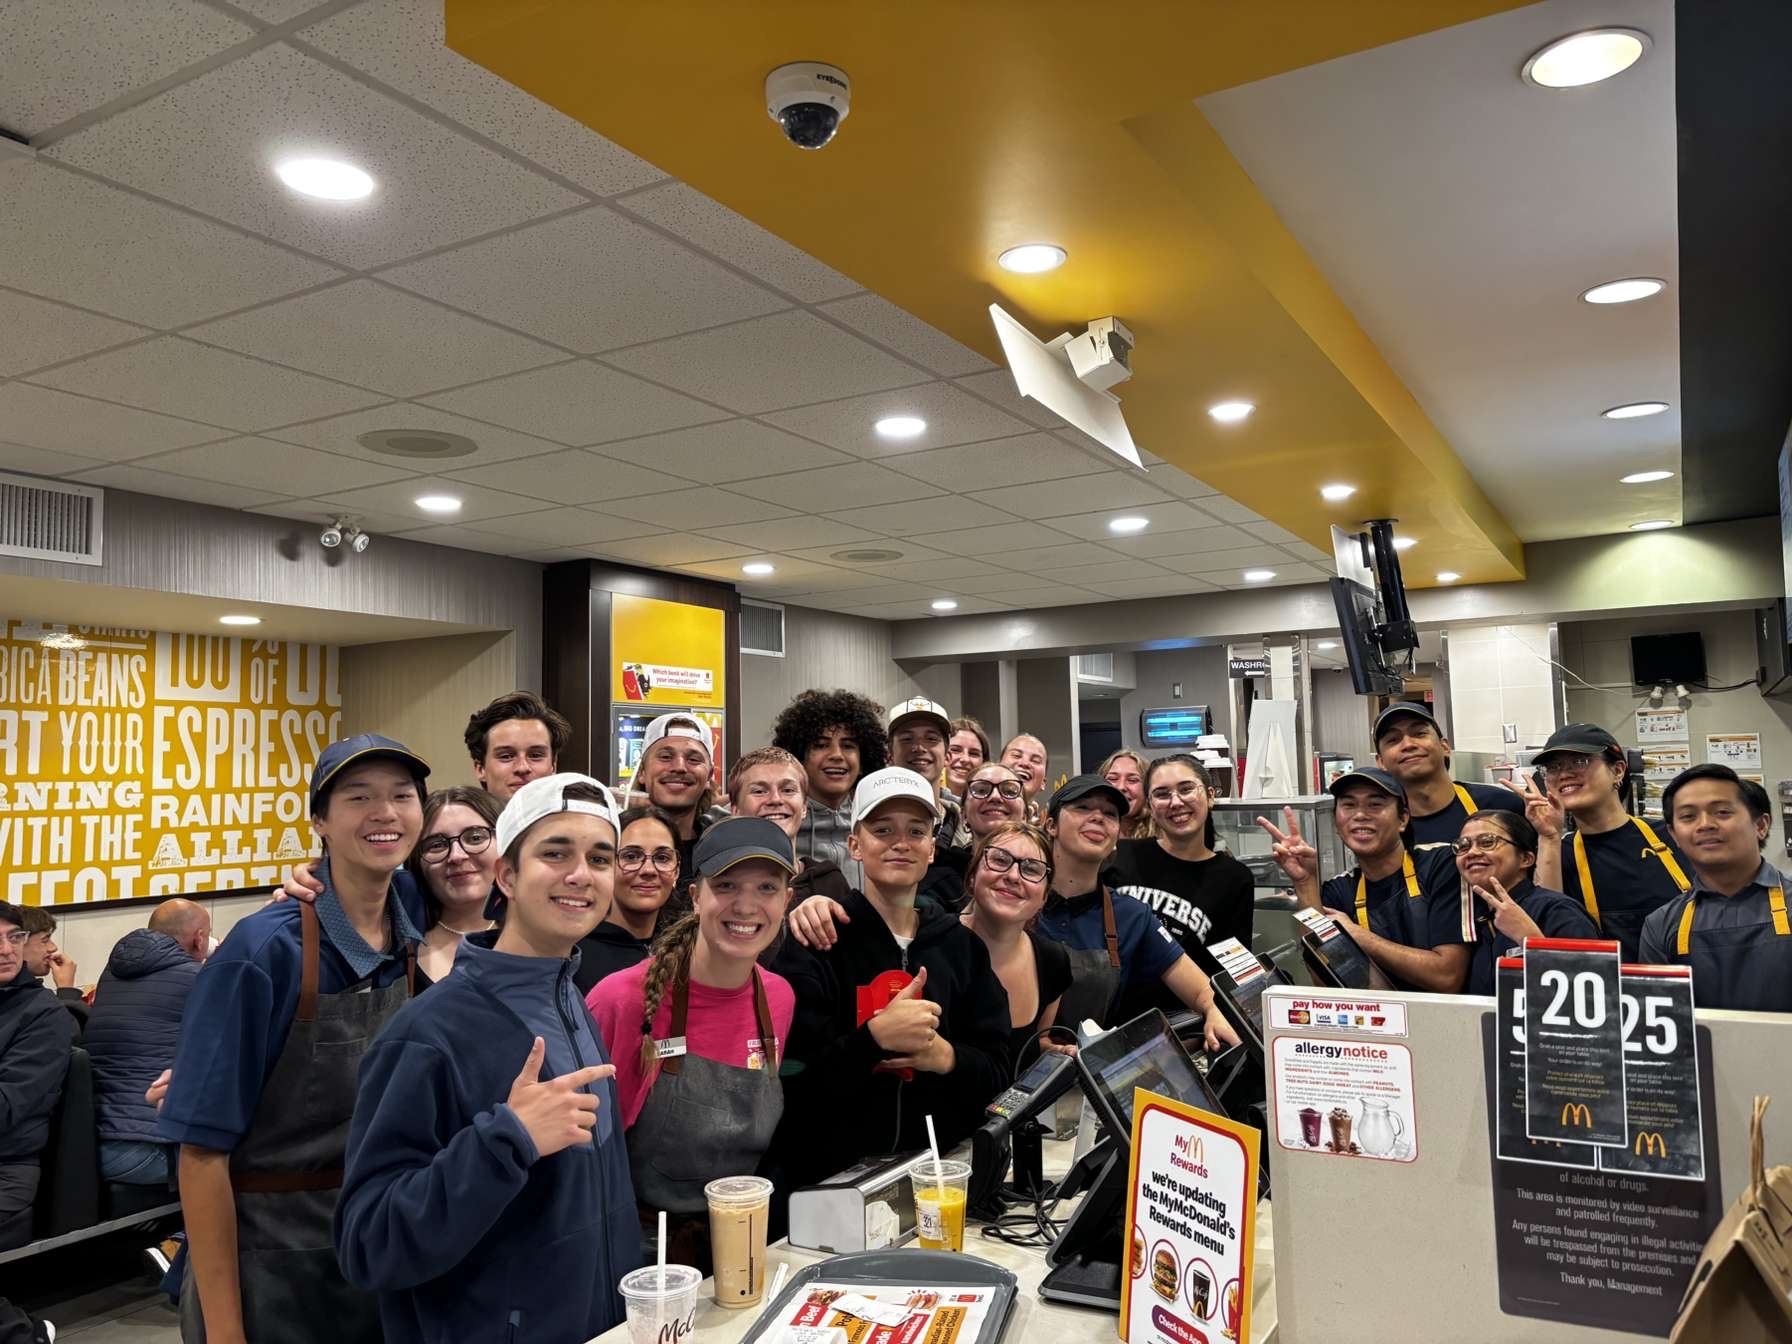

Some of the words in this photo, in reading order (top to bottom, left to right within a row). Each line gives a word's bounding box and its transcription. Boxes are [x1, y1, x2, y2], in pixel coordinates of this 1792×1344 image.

[58, 649, 146, 709] BEANS
[250, 657, 279, 704] OF
[59, 711, 144, 775] YOUR
[80, 814, 143, 862] THE
[1292, 1000, 1309, 1010] pay
[1311, 1000, 1333, 1009] how
[1335, 1002, 1353, 1012] you
[1355, 1003, 1381, 1012] want
[1540, 969, 1606, 1029] 20
[1621, 994, 1678, 1055] 25
[1174, 1135, 1188, 1152] My
[1170, 1152, 1208, 1179] Rewards
[1152, 1171, 1177, 1193] we're
[1179, 1184, 1227, 1219] updating
[1560, 1172, 1569, 1182] of
[1572, 1173, 1605, 1187] alcohol
[1607, 1179, 1616, 1188] or
[1620, 1178, 1649, 1193] drugs.
[1142, 1183, 1158, 1201] the
[1159, 1190, 1236, 1240] MyMcDonald's
[1517, 1187, 1534, 1200] This
[1536, 1192, 1554, 1202] area
[1556, 1192, 1563, 1203] is
[1565, 1195, 1608, 1209] monitored
[1609, 1198, 1620, 1211] by
[1623, 1200, 1645, 1212] video
[1647, 1205, 1700, 1218] surveillance
[1556, 1207, 1571, 1217] and
[1573, 1208, 1610, 1221] patrolled
[1612, 1213, 1658, 1229] frequently.
[1149, 1205, 1193, 1240] Rewards
[1194, 1230, 1225, 1256] menu
[1512, 1219, 1527, 1232] Any
[1530, 1223, 1561, 1235] persons
[1563, 1225, 1588, 1238] found
[1590, 1230, 1628, 1245] engaging
[1631, 1235, 1639, 1244] in
[1641, 1234, 1667, 1249] illegal
[1524, 1234, 1539, 1246] will
[1540, 1235, 1551, 1247] be
[1553, 1238, 1598, 1254] trespassed
[1600, 1242, 1620, 1256] from
[1622, 1246, 1636, 1258] the
[1638, 1250, 1678, 1264] premises
[1680, 1254, 1696, 1266] and
[1546, 1252, 1564, 1264] may
[1566, 1252, 1577, 1264] be
[1579, 1254, 1608, 1269] subject
[1611, 1259, 1620, 1269] to
[1622, 1261, 1675, 1277] prosecution.
[1560, 1271, 1586, 1286] Thank
[1587, 1277, 1605, 1289] you,
[1607, 1277, 1663, 1297] Management
[1158, 1314, 1178, 1334] Check
[1177, 1326, 1189, 1341] the
